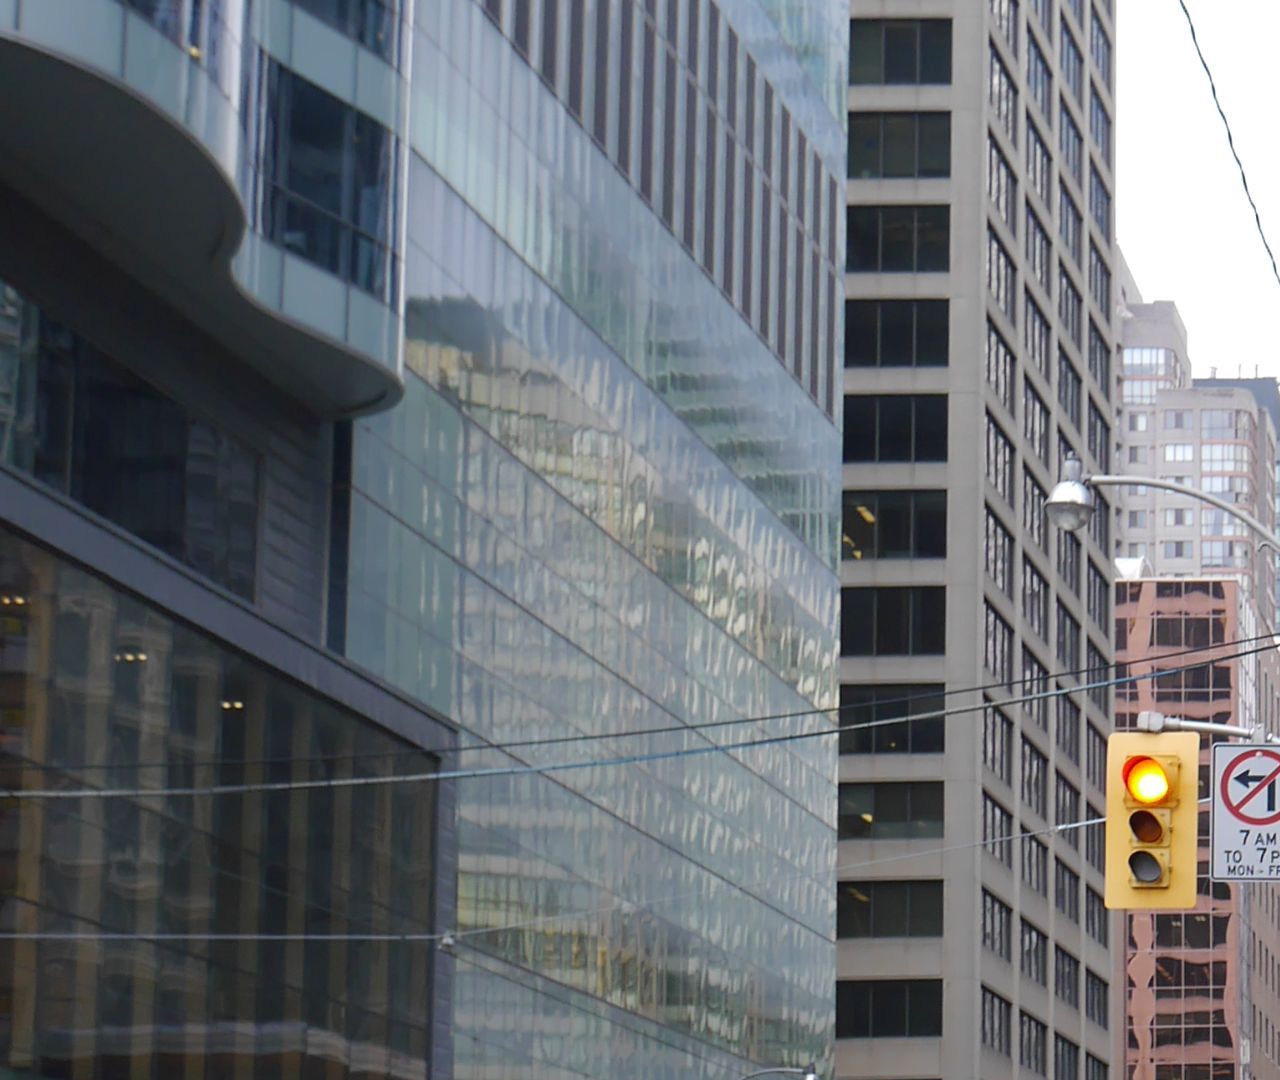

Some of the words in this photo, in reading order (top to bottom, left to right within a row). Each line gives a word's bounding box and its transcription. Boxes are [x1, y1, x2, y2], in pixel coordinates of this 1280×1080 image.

[1240, 829, 1250, 846] 7
[1255, 832, 1277, 846] AM
[1224, 850, 1242, 863] TO
[1256, 847, 1267, 863] 7
[1227, 865, 1254, 876] MON
